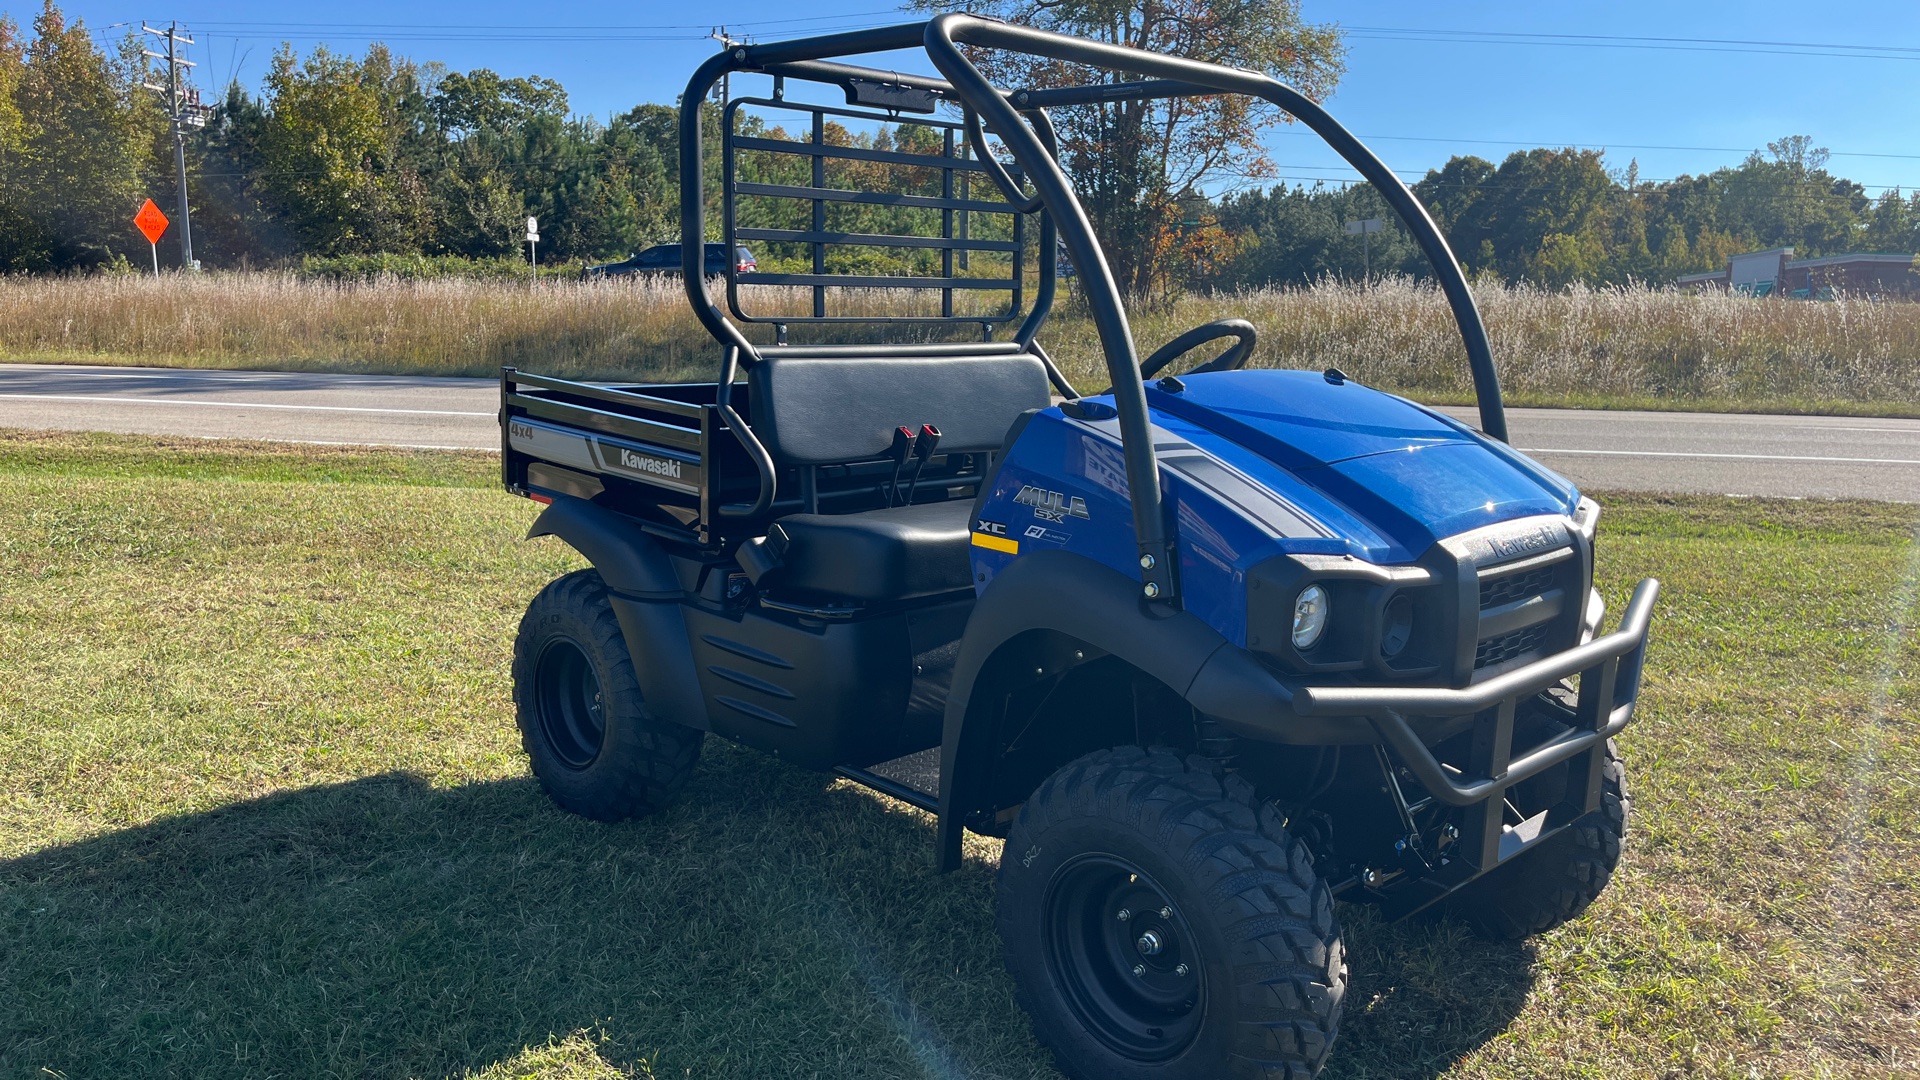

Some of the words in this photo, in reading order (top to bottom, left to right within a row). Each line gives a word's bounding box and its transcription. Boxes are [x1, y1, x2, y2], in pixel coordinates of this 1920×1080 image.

[511, 423, 534, 440] 4x4
[621, 448, 681, 479] Kawasaki
[1013, 485, 1090, 520] MULE
[978, 520, 1006, 535] XC
[1034, 508, 1064, 524] SX
[1487, 525, 1559, 559] Kawasaki
